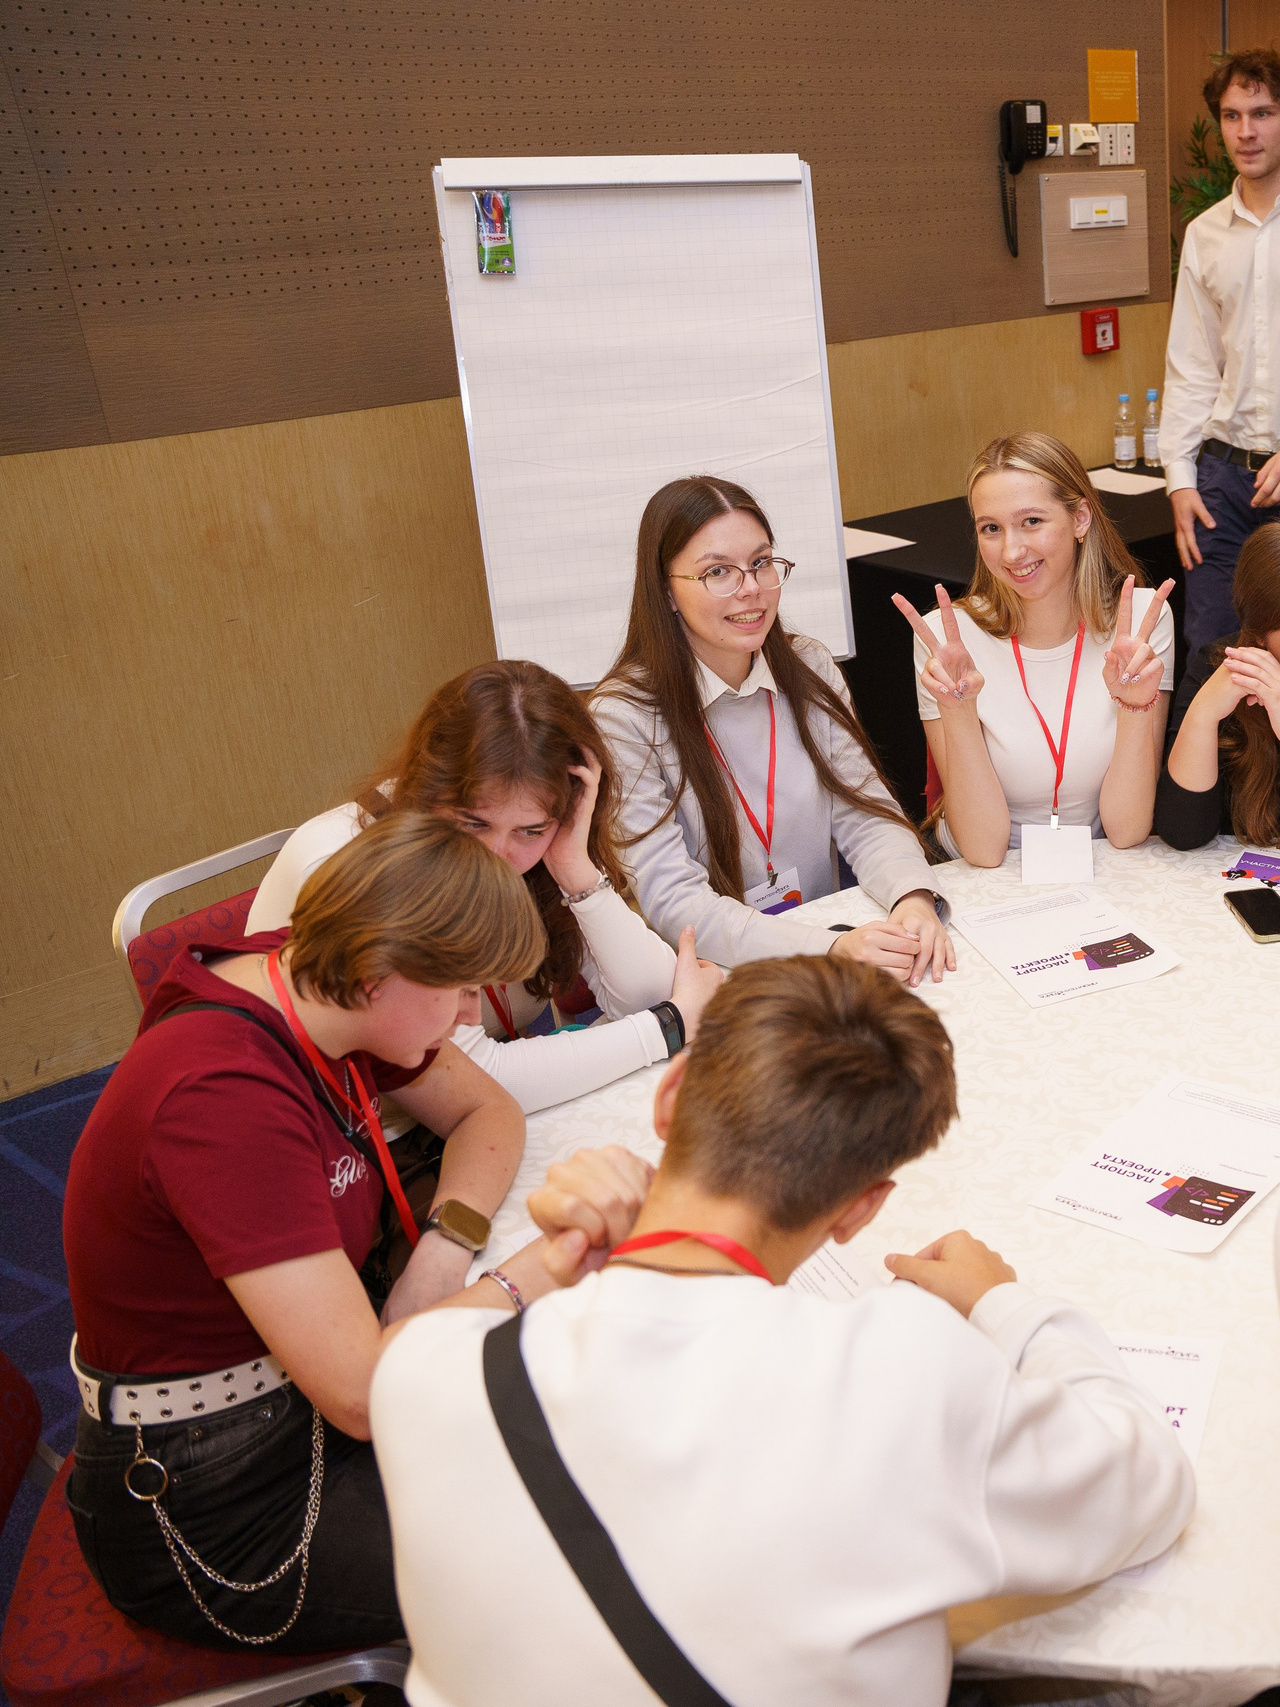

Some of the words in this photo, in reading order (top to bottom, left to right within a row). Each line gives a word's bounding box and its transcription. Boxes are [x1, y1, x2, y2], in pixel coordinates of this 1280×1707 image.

[1011, 954, 1064, 970] ПРОЕКТА
[1016, 959, 1070, 975] ПАСПОРТ
[1090, 1161, 1155, 1183] ПАСПОРТ
[1102, 1153, 1167, 1177] ПРОЕКТА
